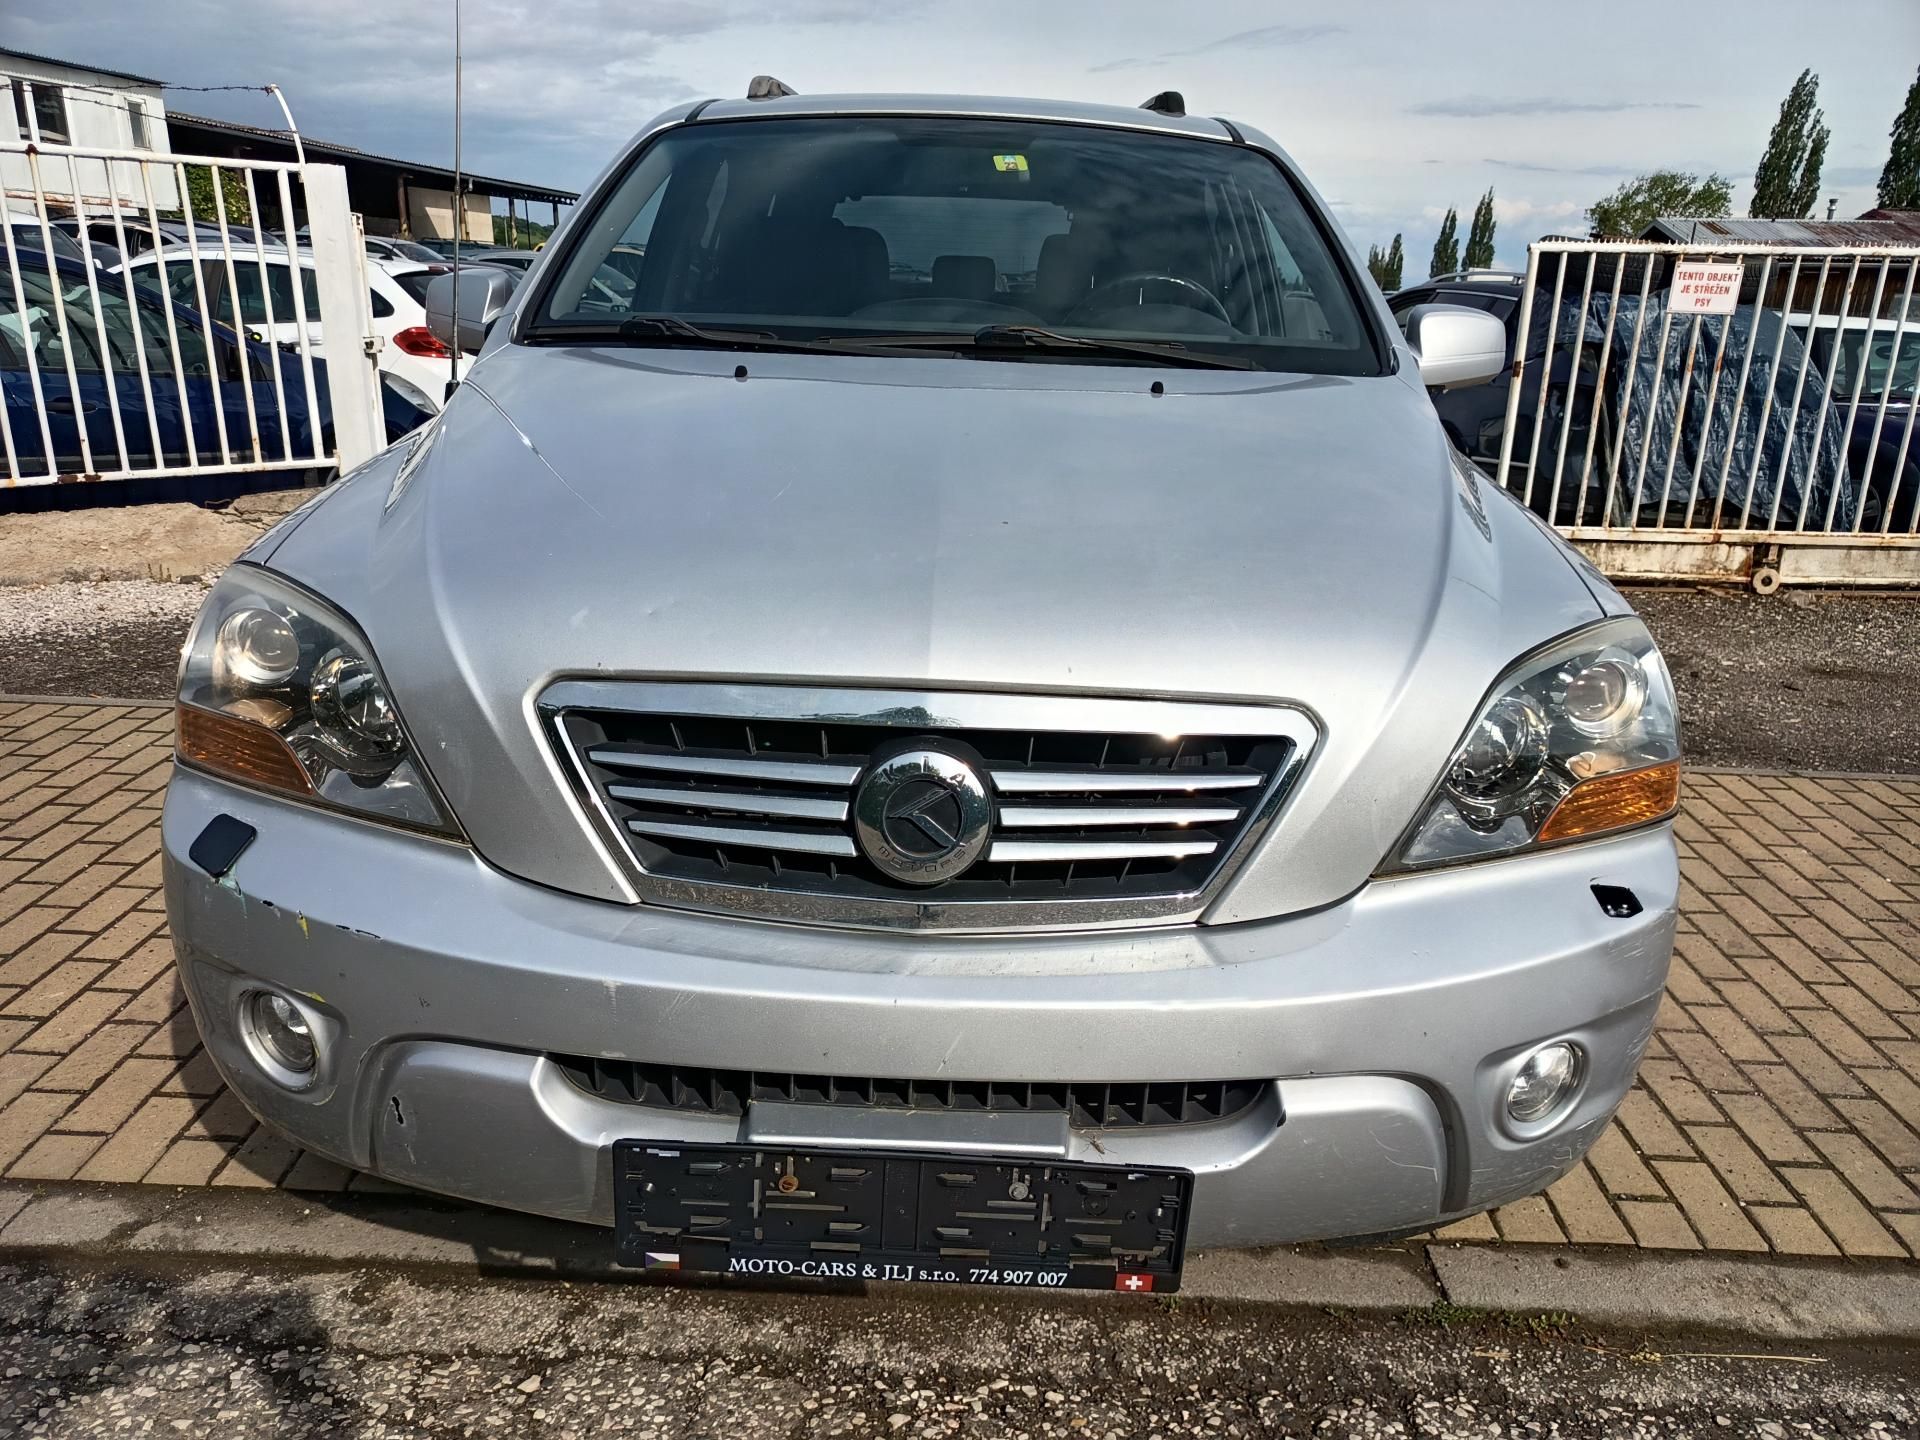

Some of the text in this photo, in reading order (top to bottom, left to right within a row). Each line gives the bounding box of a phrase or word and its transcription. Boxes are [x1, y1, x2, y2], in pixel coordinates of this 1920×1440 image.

[1678, 271, 1739, 282] TENTO OBJEKT
[1680, 283, 1730, 295] JE STŘEŽEN
[1694, 298, 1711, 307] PSY
[728, 1257, 1068, 1286] MOTO-CARS & JLJ s.r.o. 774 907 007
